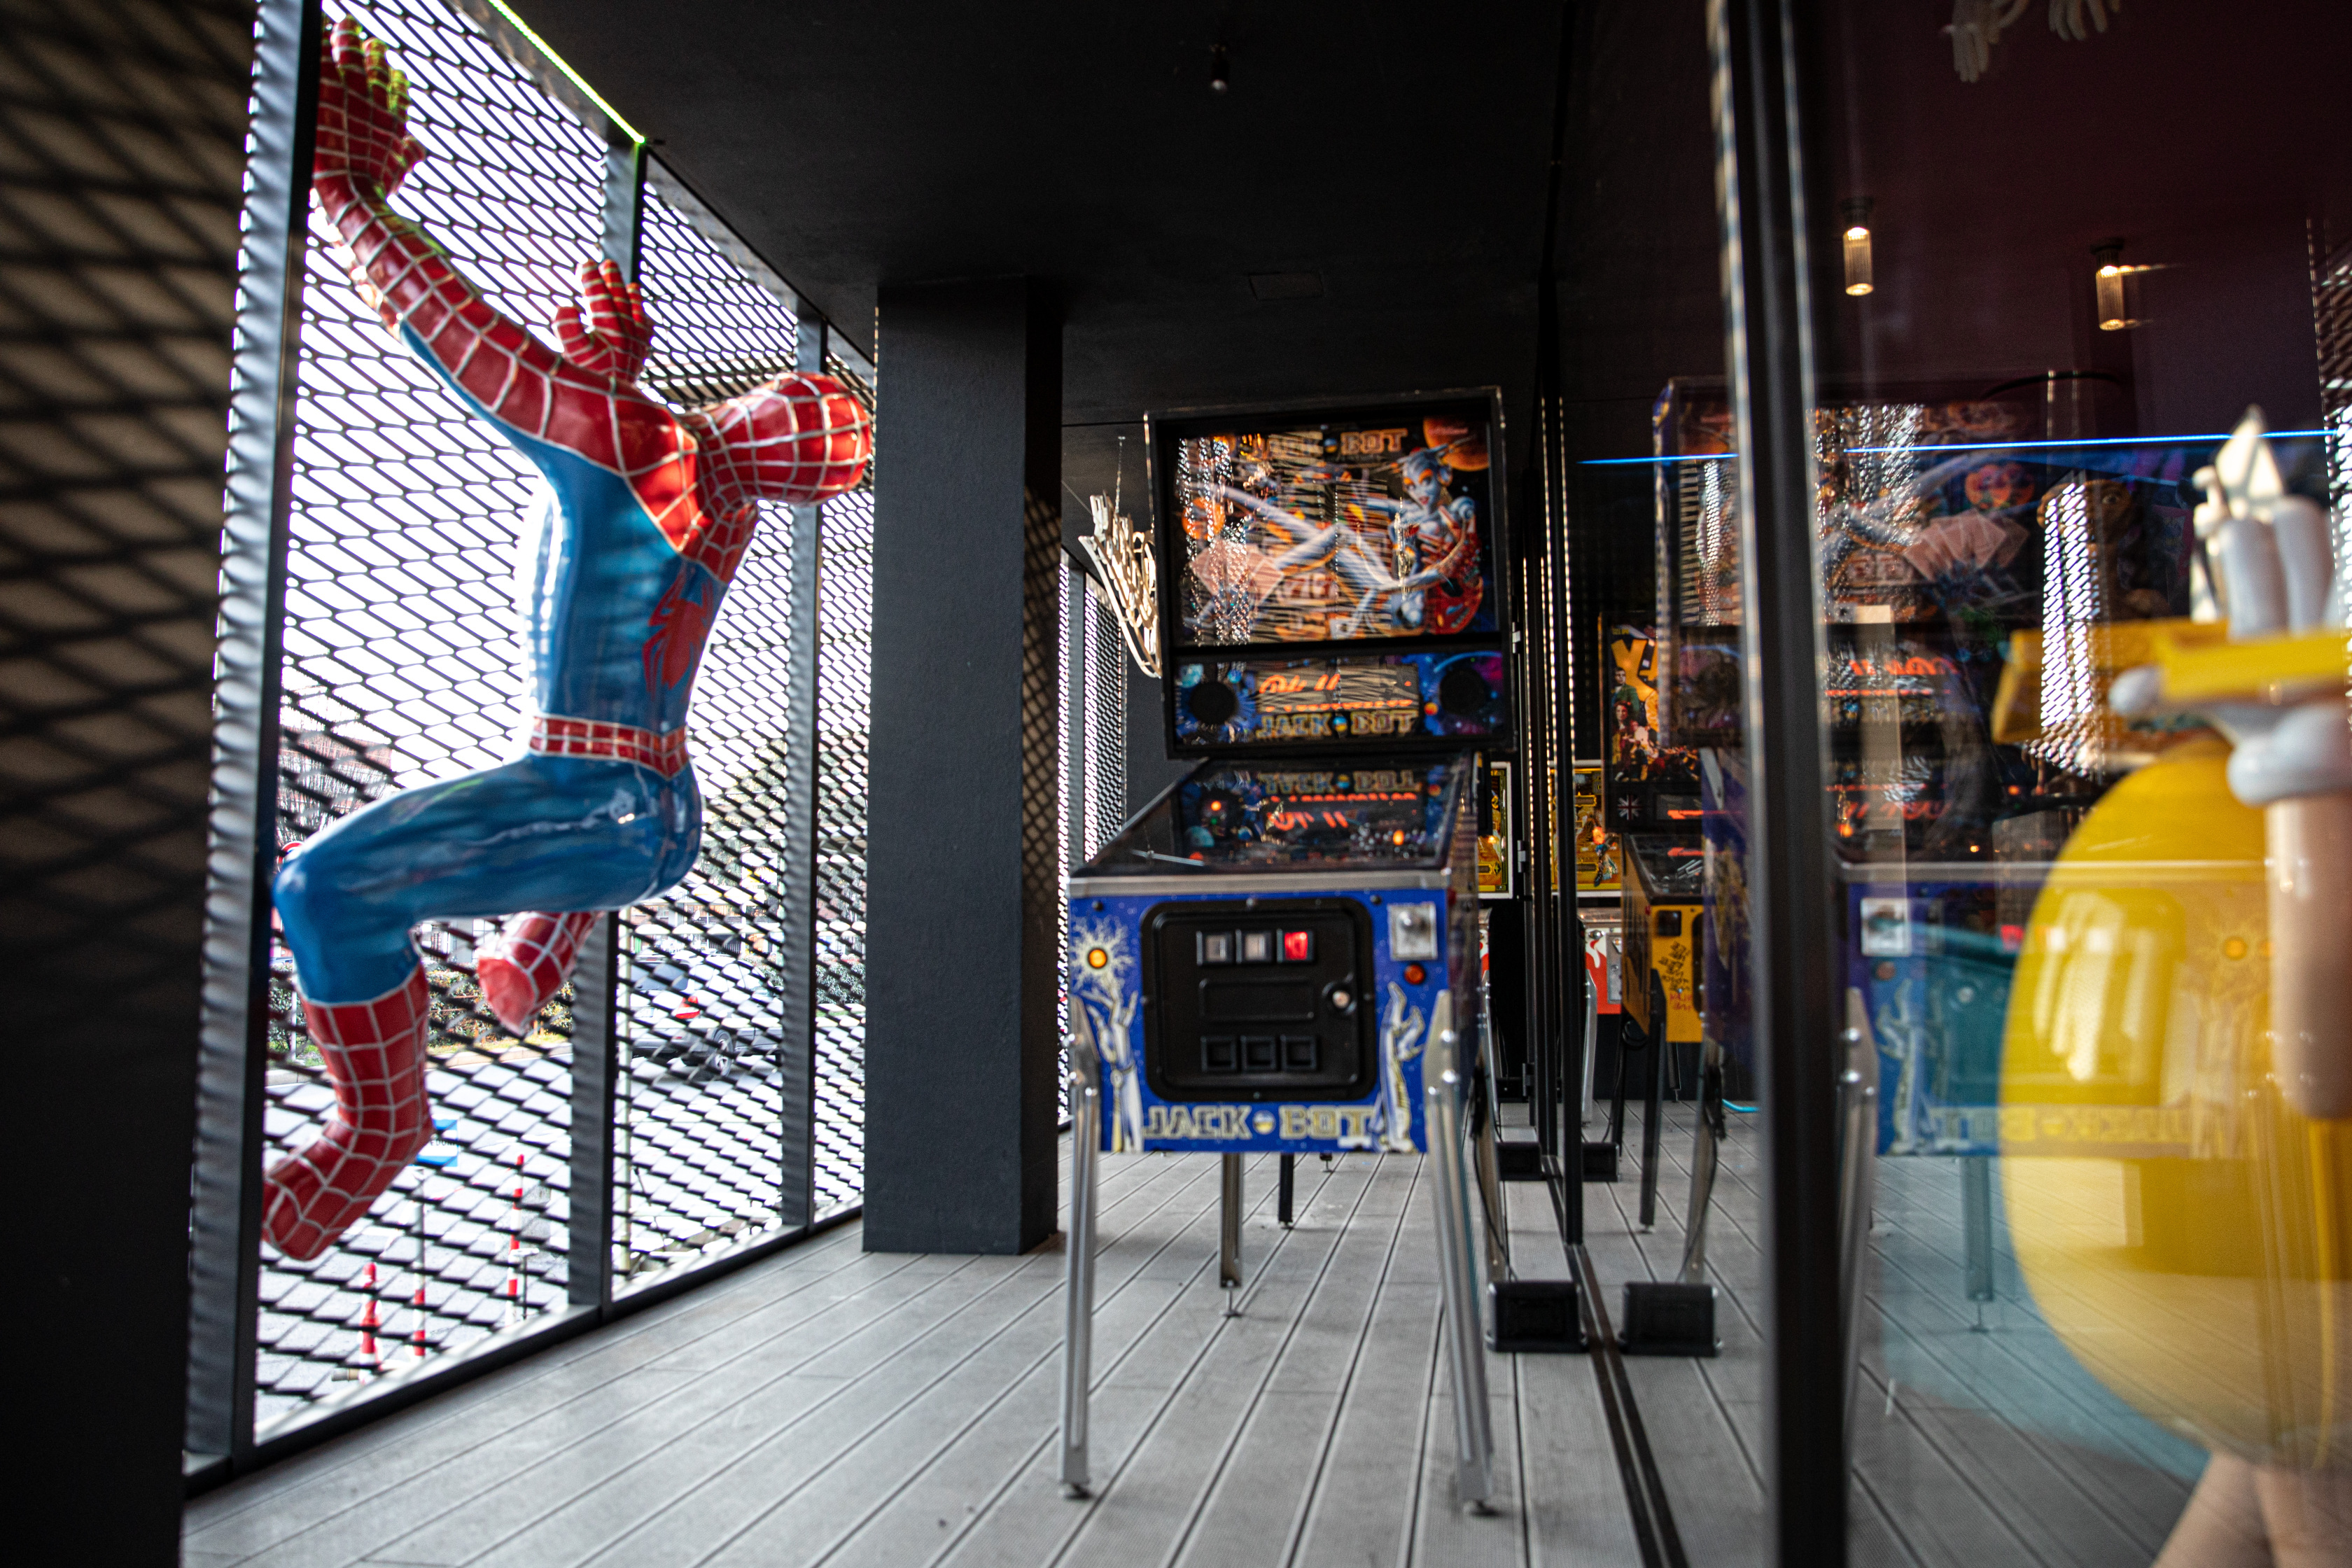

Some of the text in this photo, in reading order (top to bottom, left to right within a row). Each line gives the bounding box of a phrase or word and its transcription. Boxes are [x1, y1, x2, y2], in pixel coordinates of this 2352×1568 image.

[1256, 710, 1418, 738] JACK BOT
[1142, 1105, 1375, 1140] JACK BOT
